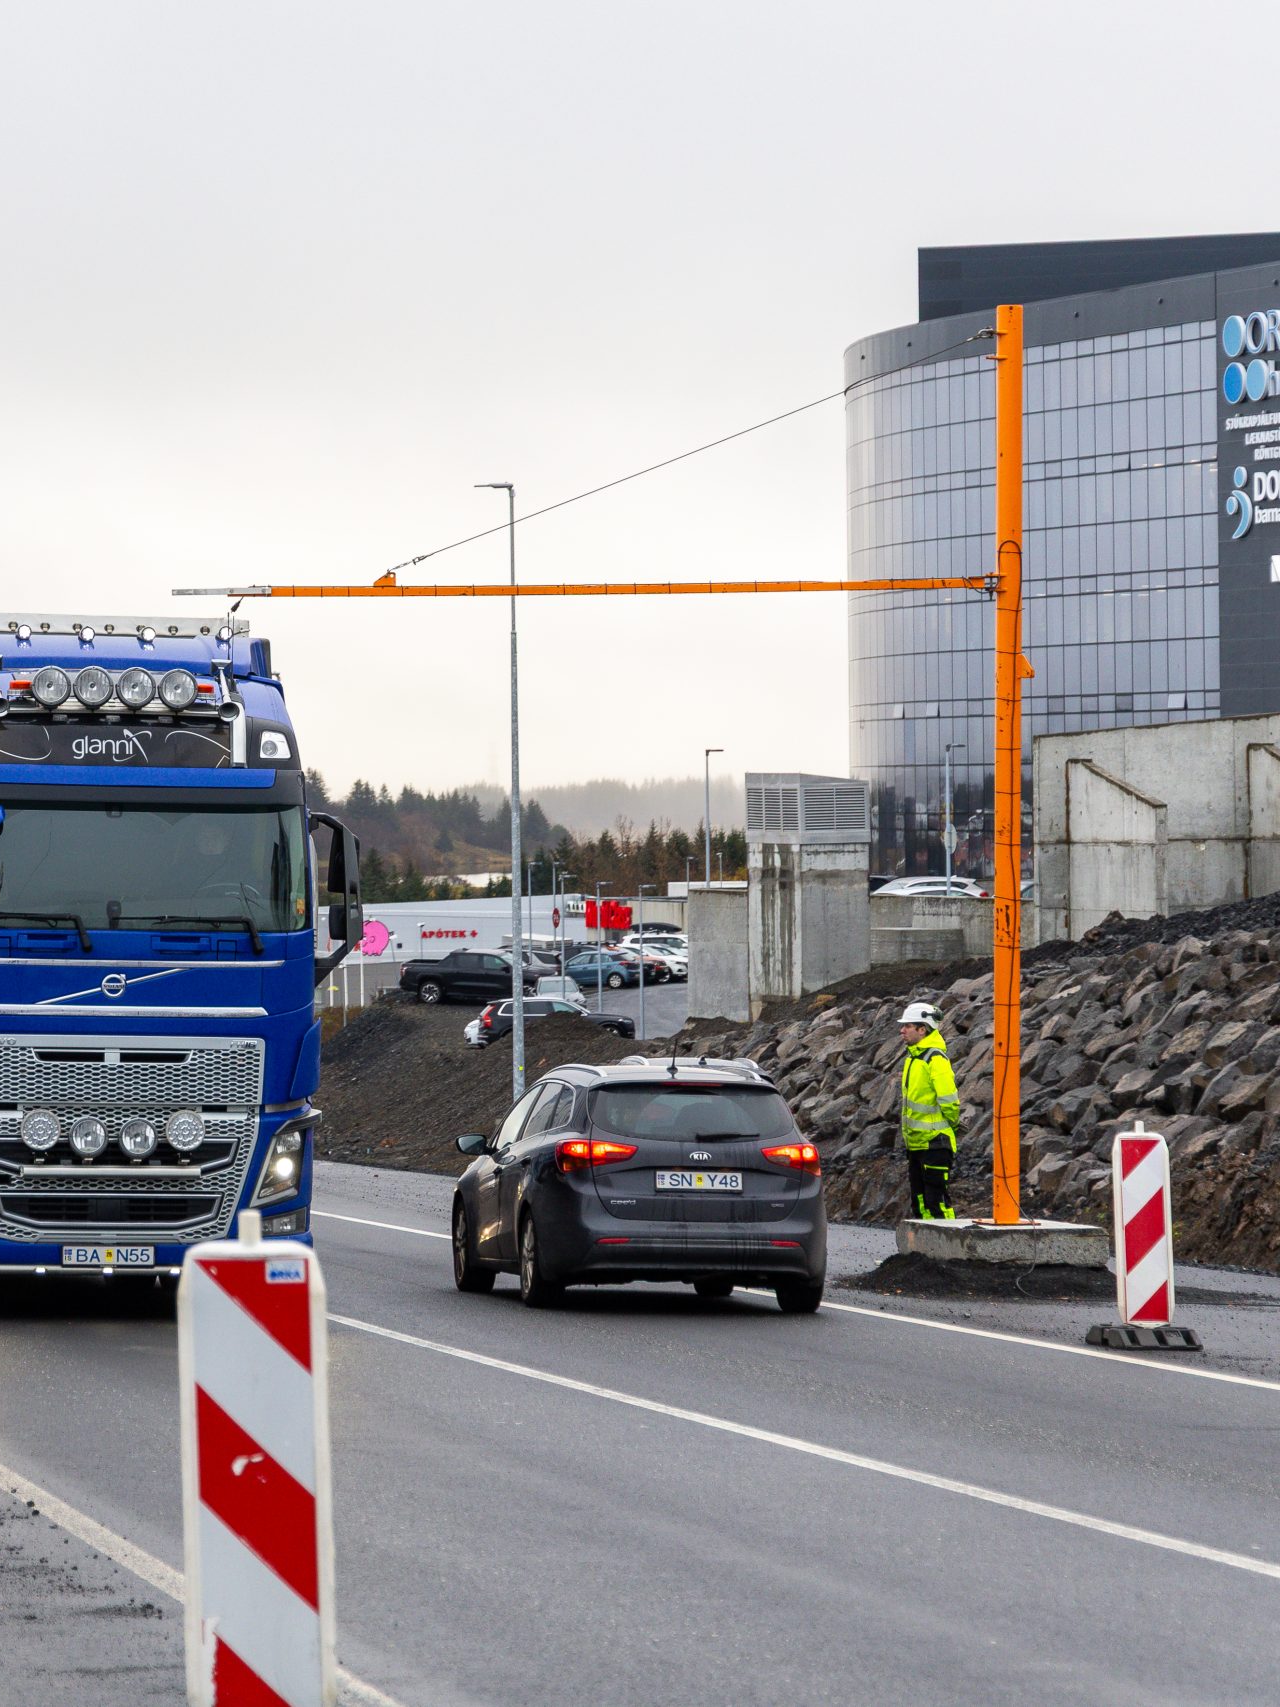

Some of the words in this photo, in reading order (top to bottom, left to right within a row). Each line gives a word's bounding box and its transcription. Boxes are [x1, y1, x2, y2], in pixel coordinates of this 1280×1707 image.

[1254, 470, 1280, 501] DO
[421, 928, 466, 938] APÓTEK
[693, 1153, 709, 1161] KIA
[669, 1173, 693, 1187] SN
[707, 1174, 739, 1188] Y48
[76, 1248, 100, 1262] BA
[116, 1248, 150, 1262] N55
